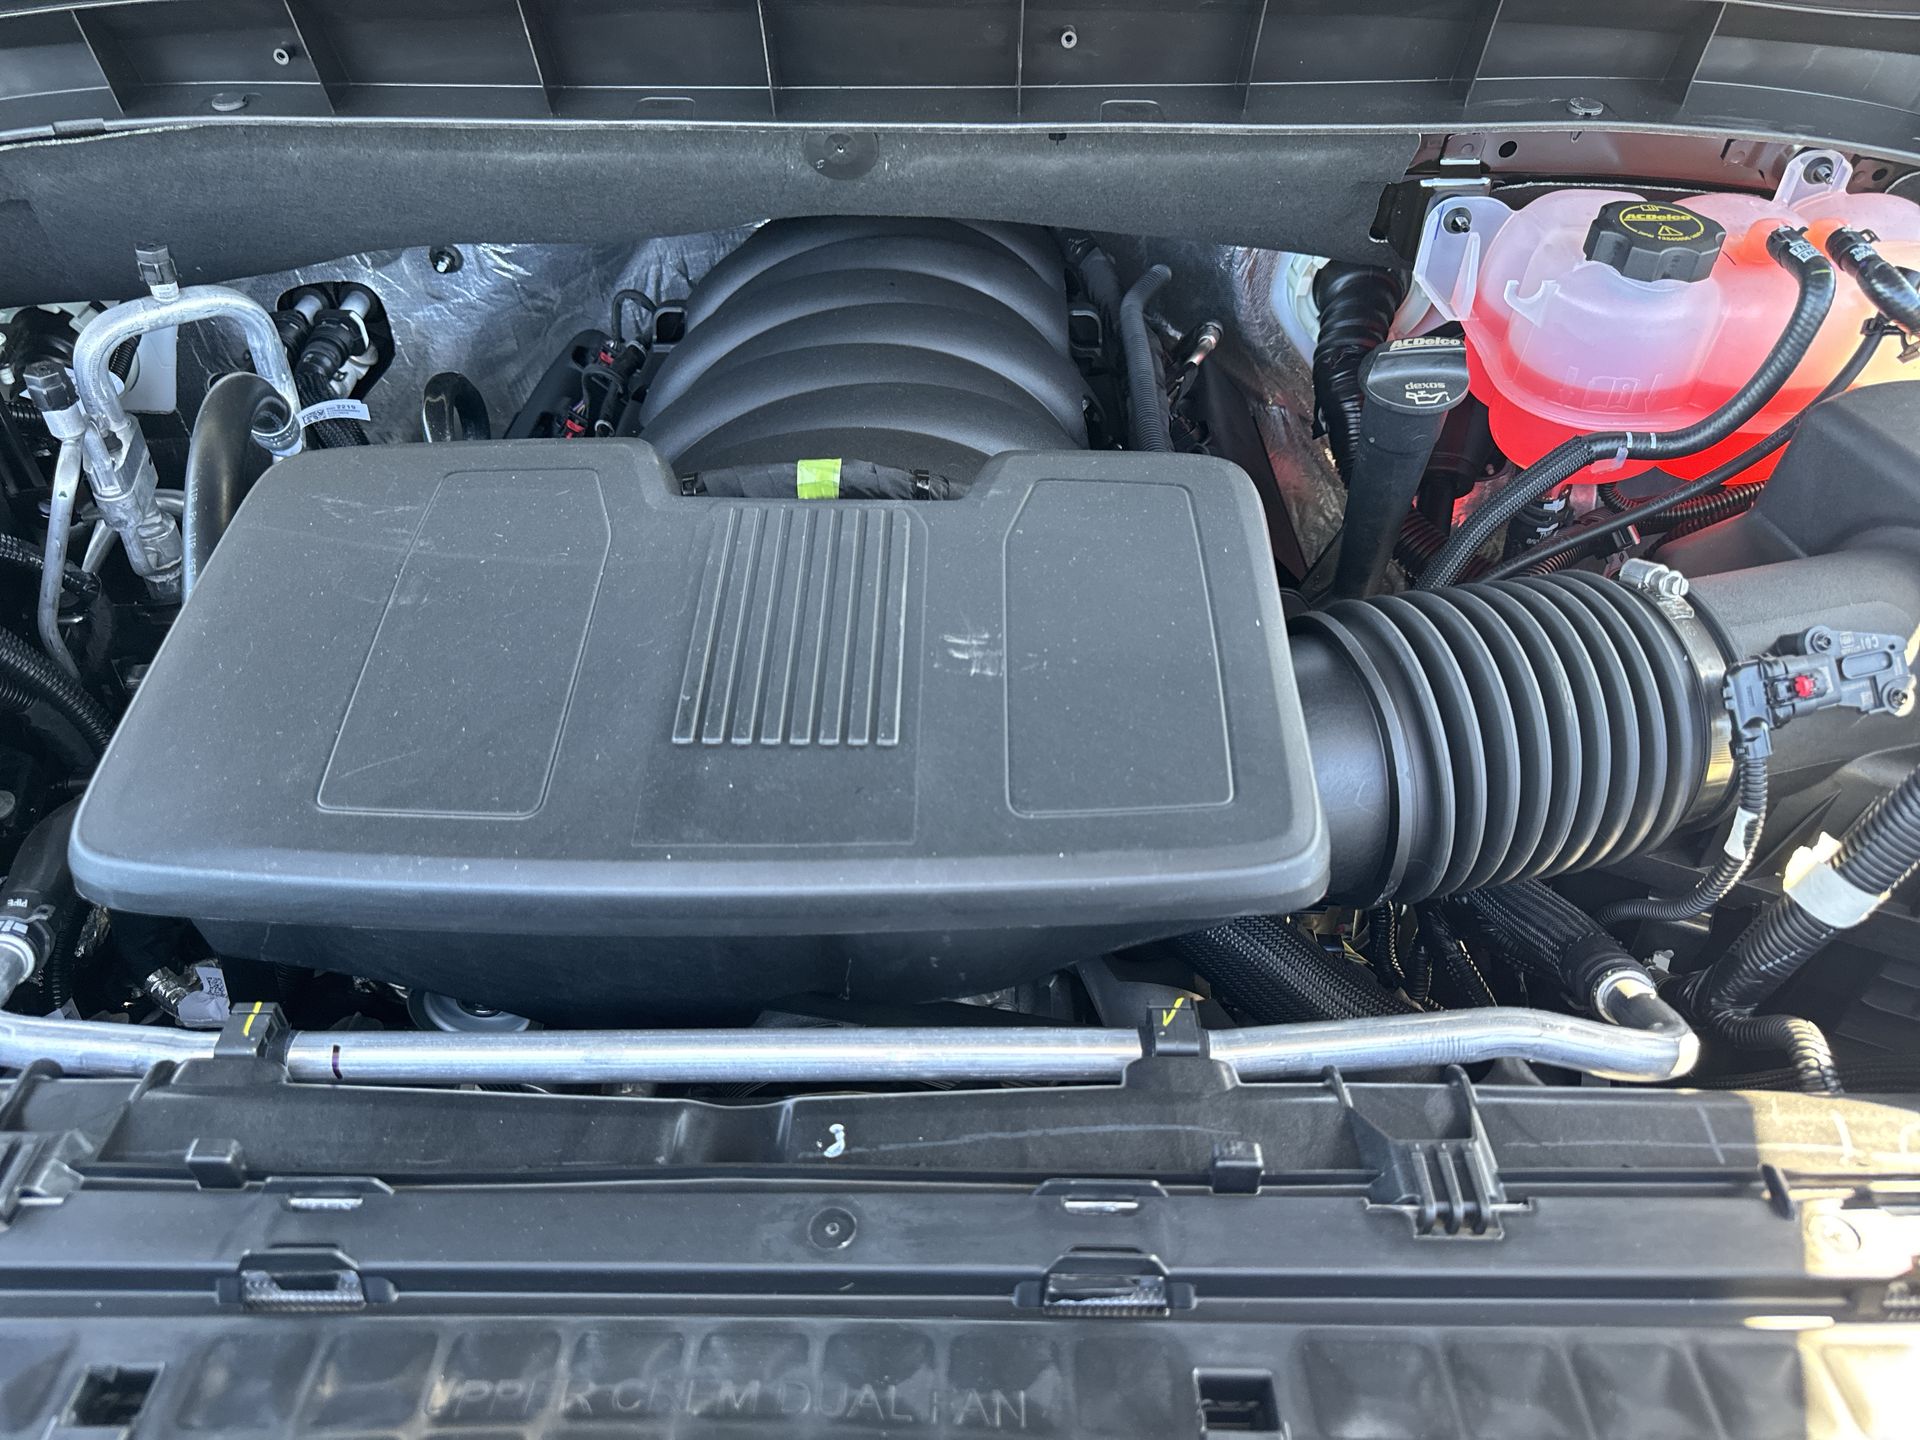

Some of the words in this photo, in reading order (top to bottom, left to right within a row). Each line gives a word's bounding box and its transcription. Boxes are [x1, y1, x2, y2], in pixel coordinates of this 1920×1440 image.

[1624, 213, 1691, 221] ACDelco
[1390, 337, 1460, 349] ACDelco
[1405, 382, 1446, 390] dexos
[7, 898, 28, 908] PIPE
[776, 1381, 913, 1422] DUAL
